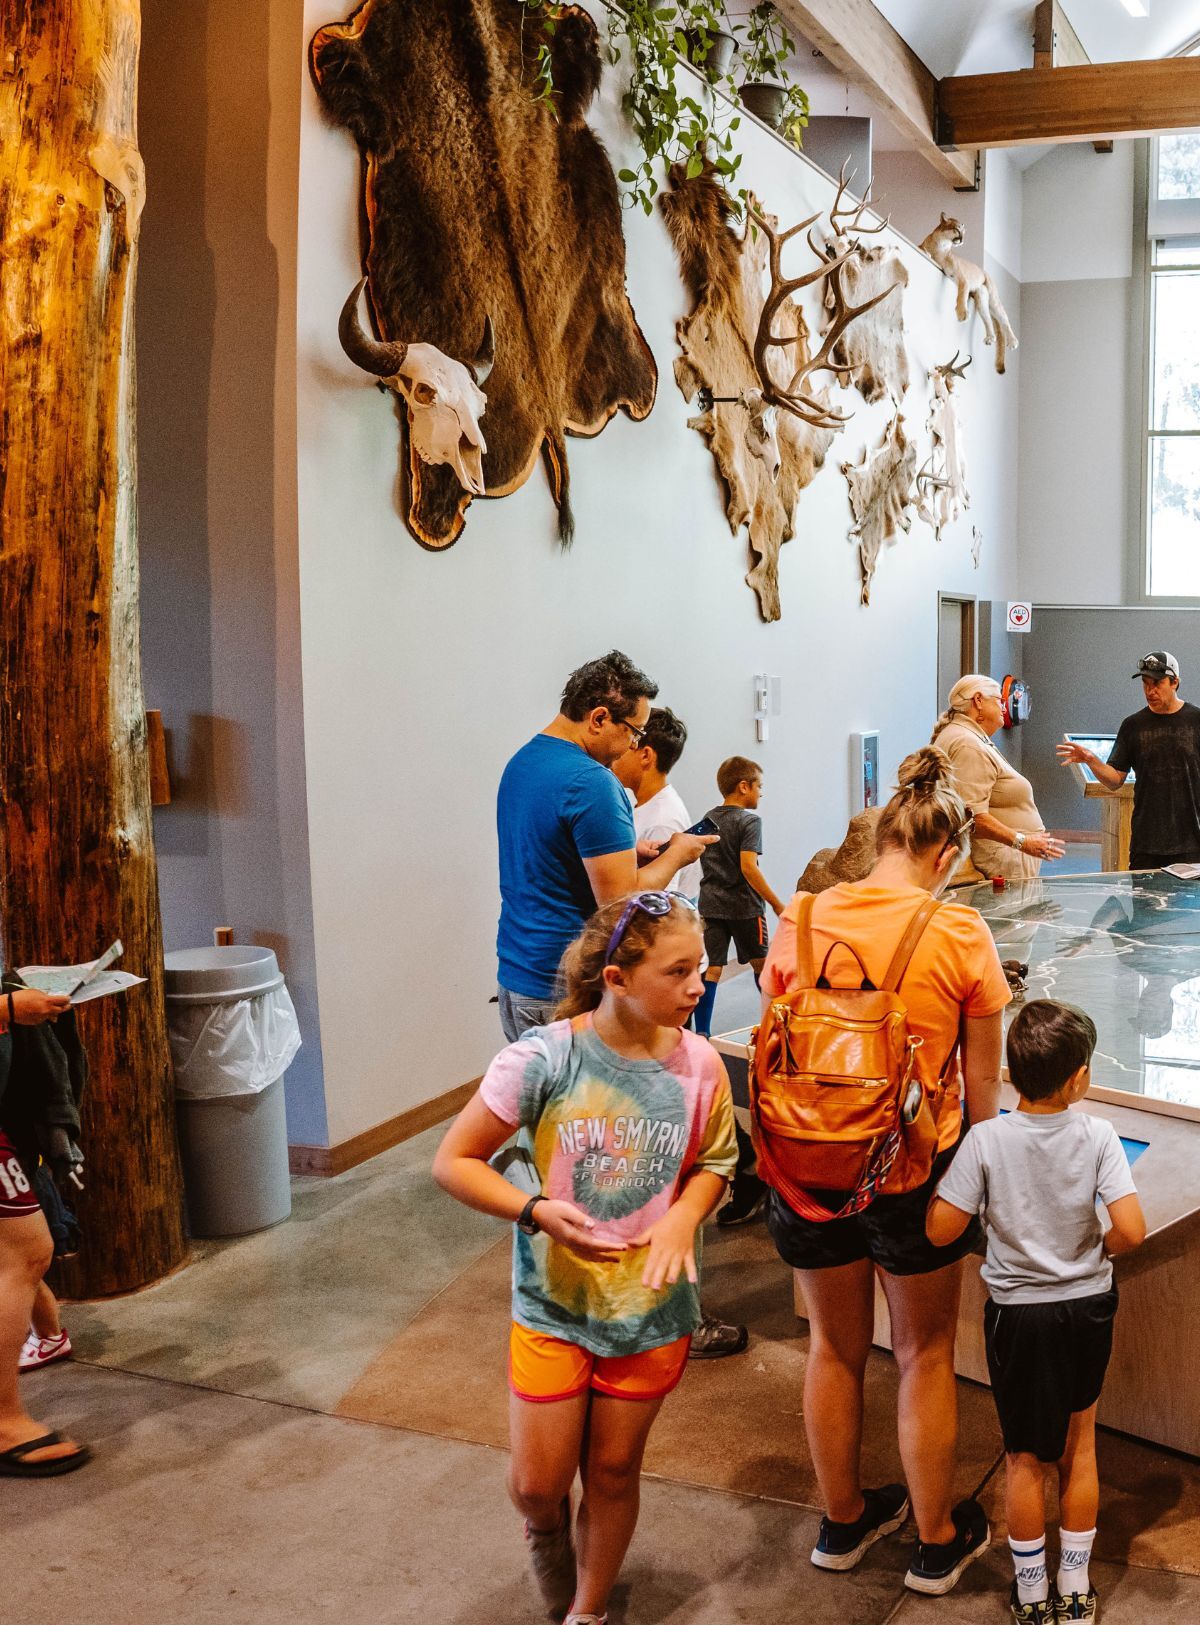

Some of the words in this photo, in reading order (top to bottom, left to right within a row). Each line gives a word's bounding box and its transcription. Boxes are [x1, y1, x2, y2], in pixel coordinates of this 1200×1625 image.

[558, 1117, 608, 1155] NEW
[583, 1152, 665, 1174] BEACH
[0, 1157, 31, 1200] 18
[580, 1171, 657, 1188] FLORIDA
